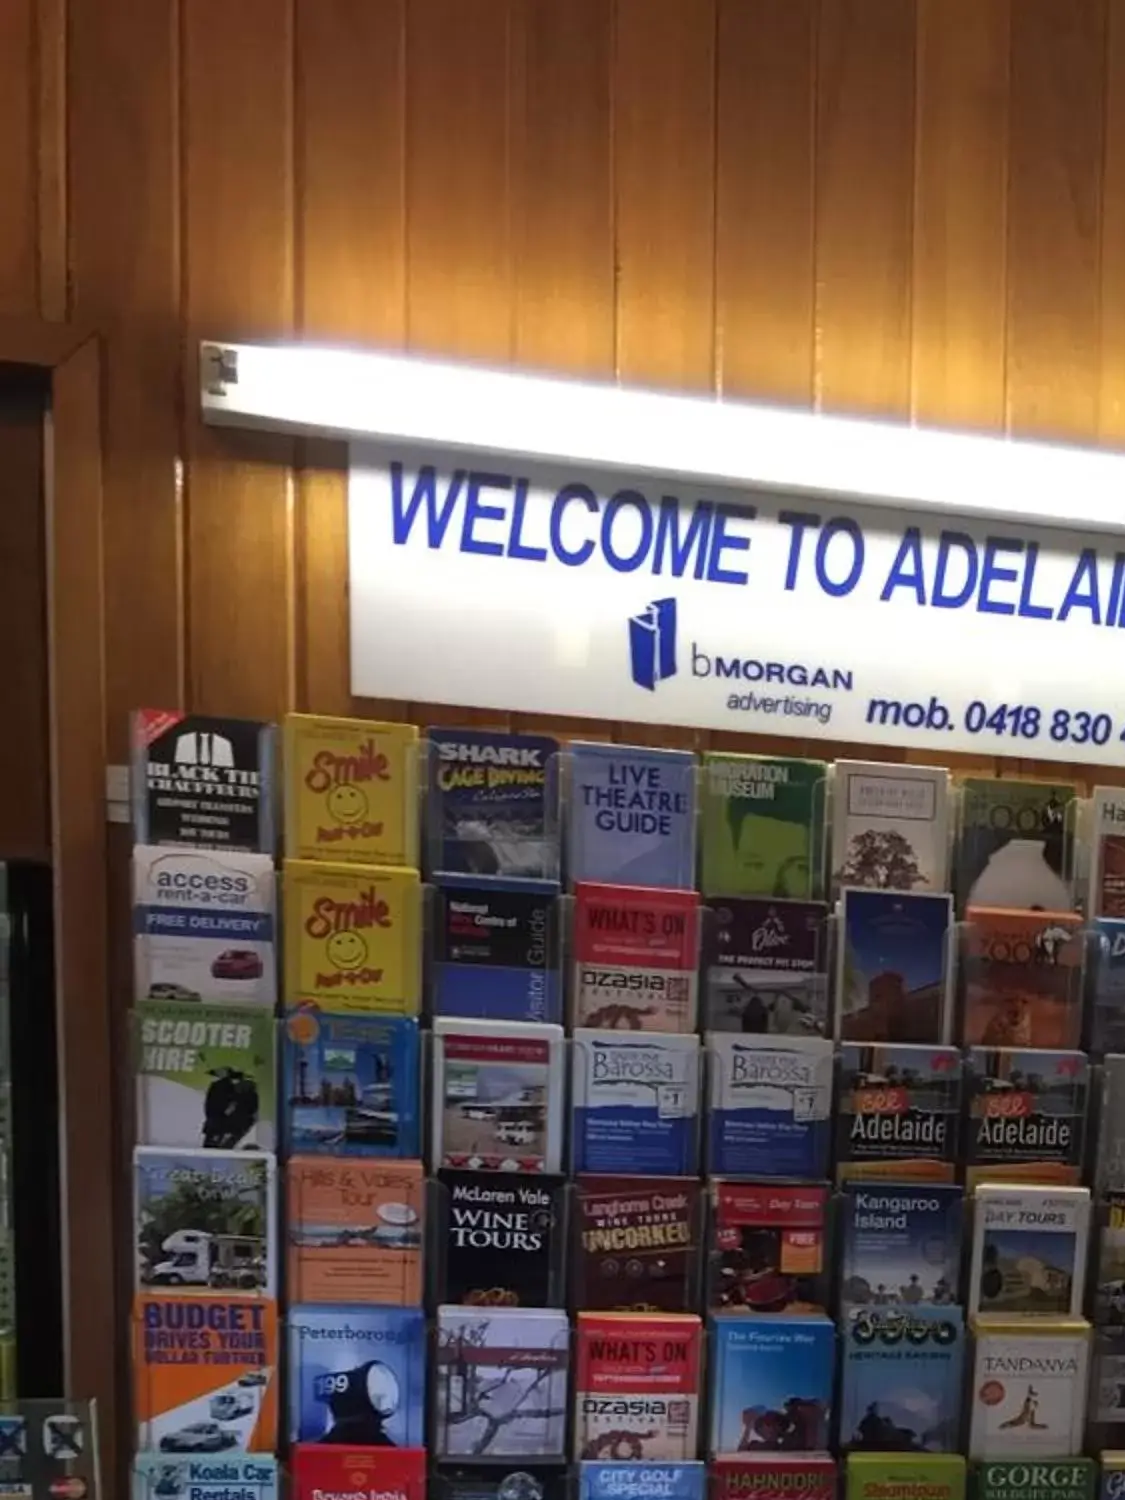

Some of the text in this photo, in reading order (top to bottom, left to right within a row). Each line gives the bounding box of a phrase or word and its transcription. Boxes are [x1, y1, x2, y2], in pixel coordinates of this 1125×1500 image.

[389, 461, 756, 587] WELCOME
[783, 503, 866, 599] TO
[726, 688, 833, 724] advertising
[866, 694, 956, 733] mob.
[964, 701, 1043, 740] 0418
[1051, 710, 1114, 746] 830
[305, 738, 392, 793] Smile
[439, 742, 541, 767] SHARK
[147, 762, 220, 782] BLACK
[438, 767, 485, 790] CAGE
[608, 763, 661, 788] LIVE
[582, 785, 687, 814] THEATRE
[710, 781, 775, 800] MUSEUM
[595, 810, 672, 835] GUIDE
[157, 870, 249, 892] access
[157, 887, 248, 905] rent-a-car
[147, 912, 260, 931] FREE DELIVERY
[305, 886, 393, 939] Smile
[588, 908, 685, 938] WHAT'S ON
[527, 908, 546, 966] Guide
[141, 1020, 252, 1048] SCOOTER
[142, 1046, 198, 1072] HIRE
[592, 1050, 674, 1080] Barossa
[731, 1054, 812, 1084] Barossa
[850, 1112, 946, 1144] Adelaide
[976, 1117, 1072, 1147] Adelaide
[452, 1186, 550, 1205] McLaren Vale
[855, 1193, 940, 1214] Kangaroo
[451, 1207, 529, 1231] WINE
[854, 1213, 908, 1230] Island
[984, 1210, 1067, 1225] DAY TOURS
[451, 1227, 542, 1251] TOURS
[144, 1302, 266, 1330] BUDGET
[144, 1330, 266, 1350] DRIVES YOUR
[588, 1341, 688, 1363] WHAT'S ON
[984, 1356, 1079, 1373] TANDANYA
[315, 1375, 349, 1395] 199
[189, 1463, 273, 1481] Koala Car
[598, 1469, 683, 1484] CITY GOLF
[987, 1465, 1087, 1488] GORGE
[606, 1482, 673, 1497] SPECIAL
